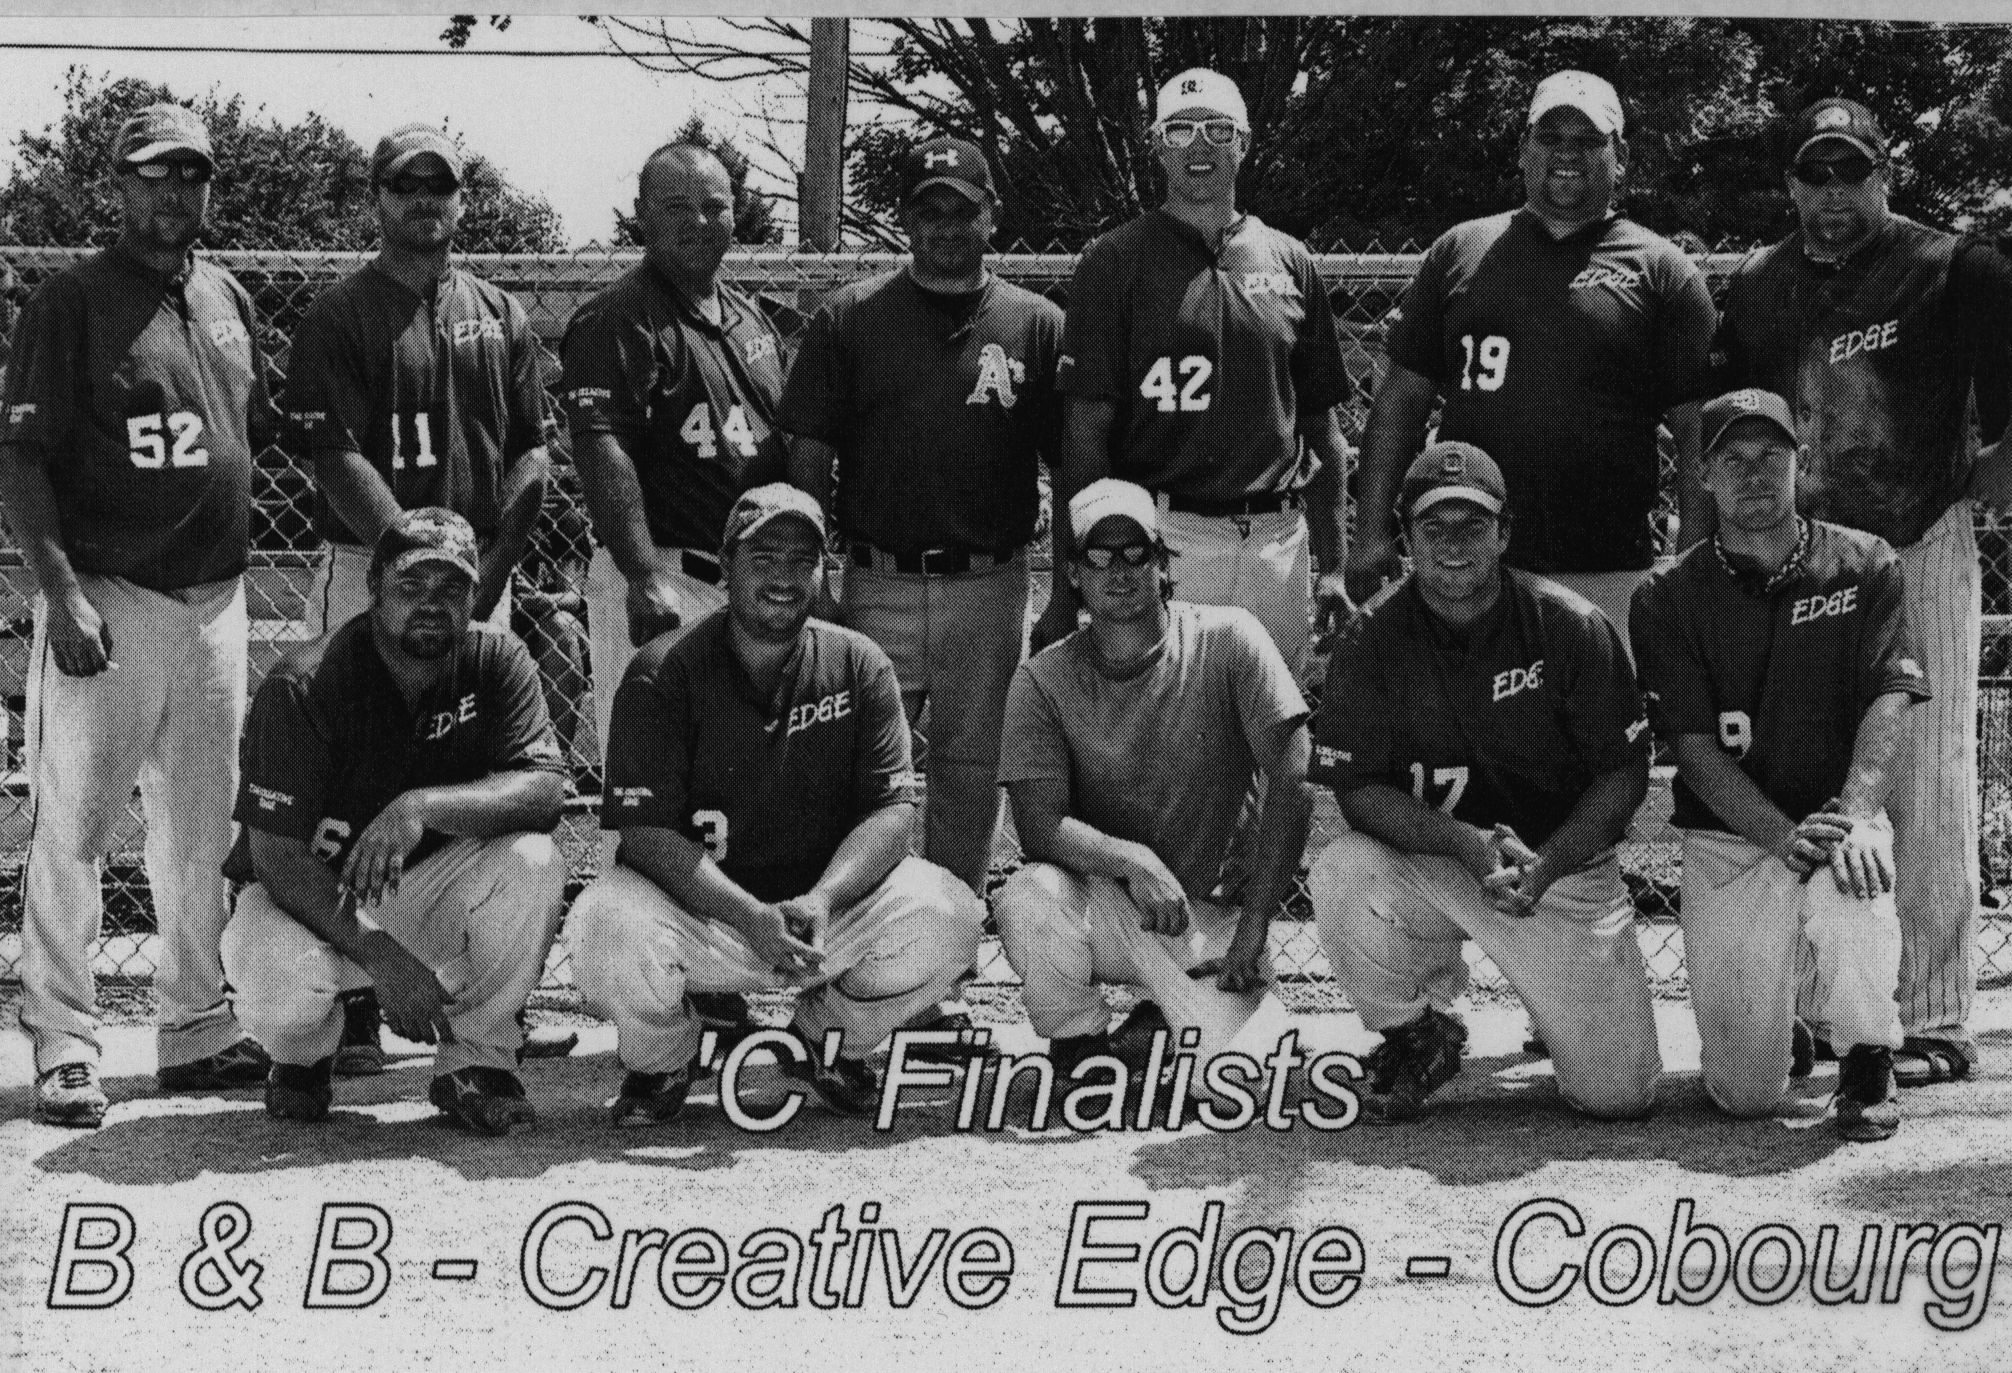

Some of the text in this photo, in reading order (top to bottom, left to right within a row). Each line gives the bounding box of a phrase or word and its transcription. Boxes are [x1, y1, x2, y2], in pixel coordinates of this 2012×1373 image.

[1461, 334, 1511, 391] 19
[1829, 320, 1899, 365] EDGE
[1140, 355, 1213, 412] 42
[126, 411, 209, 469] 52
[391, 411, 437, 470] 11
[680, 401, 759, 459] 44
[1792, 585, 1859, 625] EDGE
[786, 690, 851, 737] EDGE
[1719, 711, 1752, 761] 9
[1410, 763, 1468, 815] 17
[693, 810, 727, 861] 3
